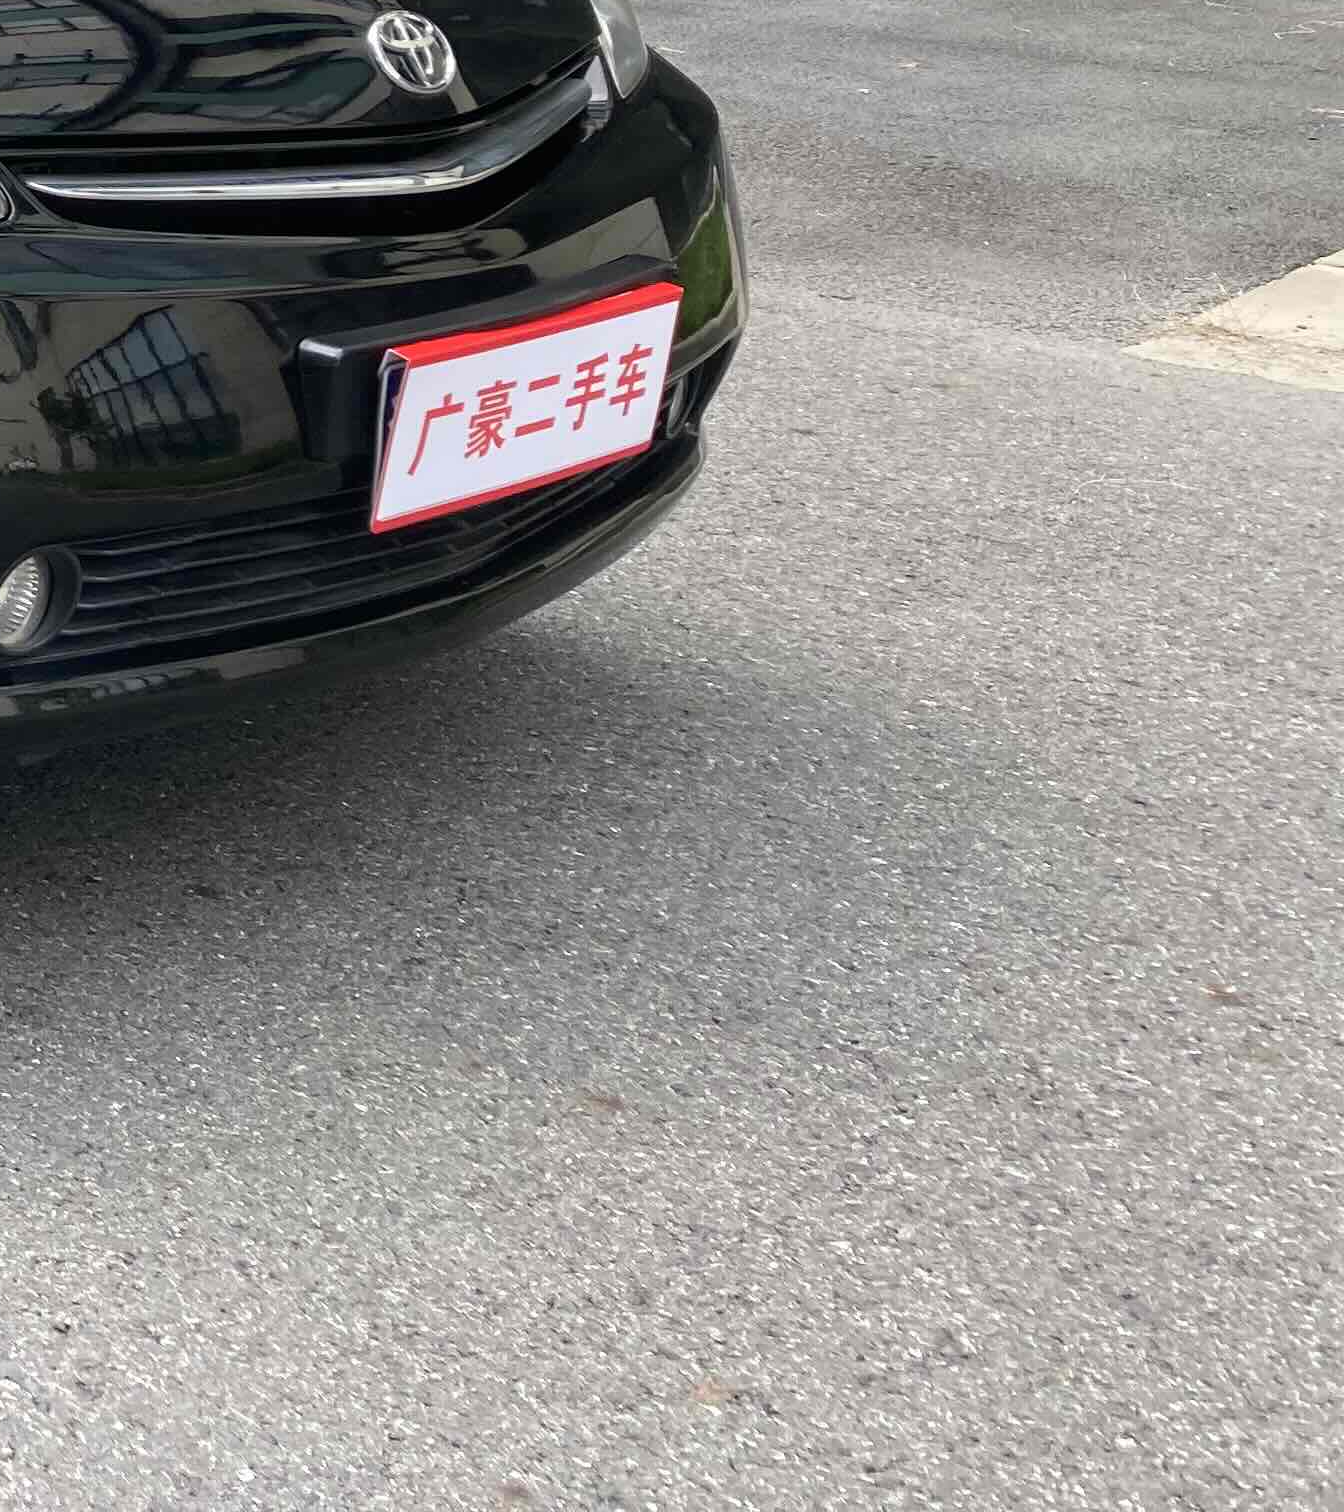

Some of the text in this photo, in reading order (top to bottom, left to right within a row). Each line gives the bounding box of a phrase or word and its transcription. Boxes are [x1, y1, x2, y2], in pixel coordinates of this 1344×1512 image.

[408, 343, 653, 476] 广豪二手车
